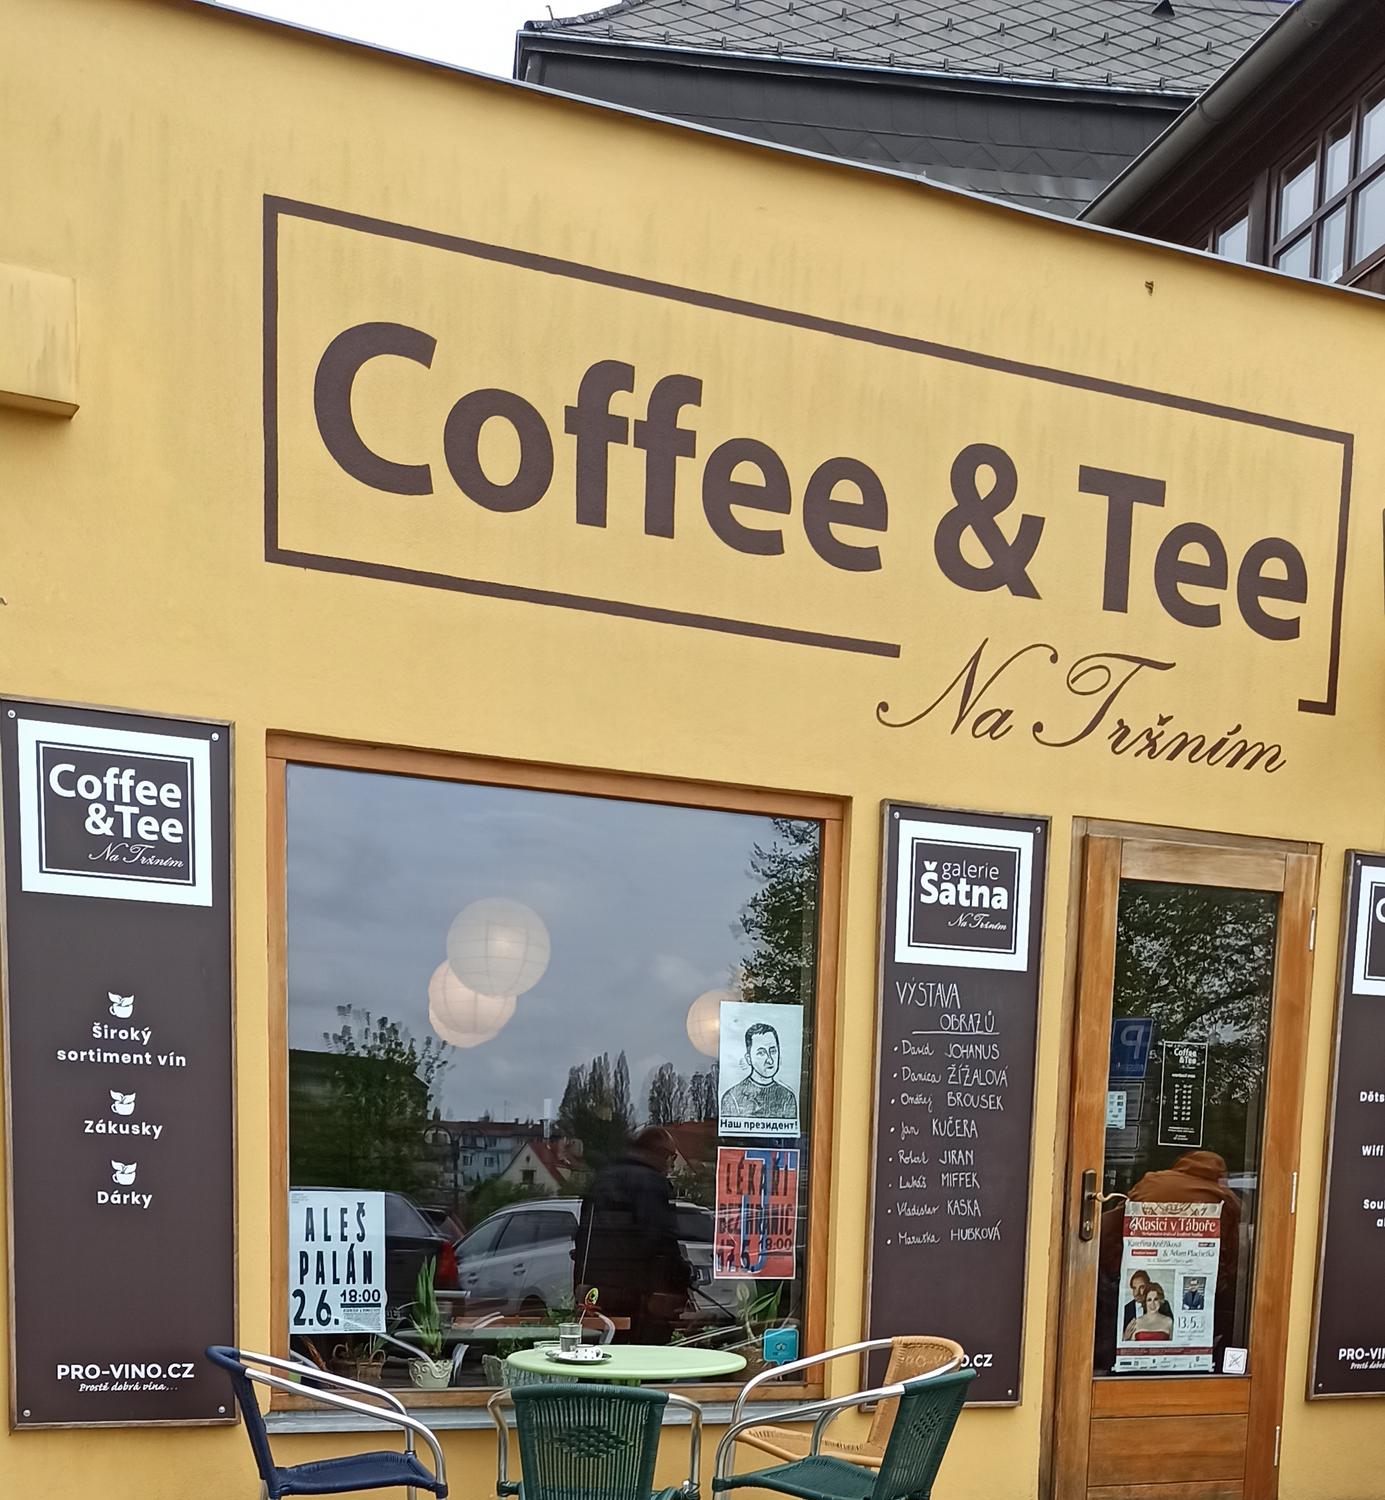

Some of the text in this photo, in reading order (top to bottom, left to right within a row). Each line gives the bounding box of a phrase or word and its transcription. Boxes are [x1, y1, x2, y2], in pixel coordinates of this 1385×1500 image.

[313, 321, 1308, 641] Coffee & Tee
[876, 637, 1287, 773] Na Tržním
[49, 763, 182, 809] Coffee
[84, 802, 184, 844] &Tee
[88, 842, 184, 868] Na Tržním
[941, 859, 999, 881] galerie
[920, 860, 1008, 910] Šatna
[948, 912, 974, 928] Na
[895, 977, 961, 1010] VÝSTAVA
[92, 1022, 152, 1045] Široký
[56, 1048, 186, 1067] sortiment vín
[901, 1039, 1000, 1060] David JOHANUS
[946, 1063, 1009, 1088] ŽÍŽALOVÁ
[946, 1091, 1004, 1111] BROUSEK
[84, 1119, 163, 1140] Zákusky
[720, 1119, 798, 1130] Наш президент!
[931, 1115, 979, 1139] KUČERA
[938, 1149, 974, 1166] JIRAN
[1362, 1144, 1384, 1156] Wifi
[97, 1190, 153, 1209] Dárky
[1363, 1198, 1385, 1210] Sou
[305, 1202, 366, 1242] ALEŠ
[950, 1219, 1002, 1241] HUBKOVÁ
[1170, 1221, 1177, 1231] v
[299, 1243, 373, 1285] PALÁN
[340, 1289, 381, 1303] 18:00
[292, 1289, 340, 1327] 2.6.
[57, 1363, 195, 1380] PRO-VINO.CZ
[78, 1382, 109, 1392] Prostě
[110, 1381, 141, 1391] dobrá
